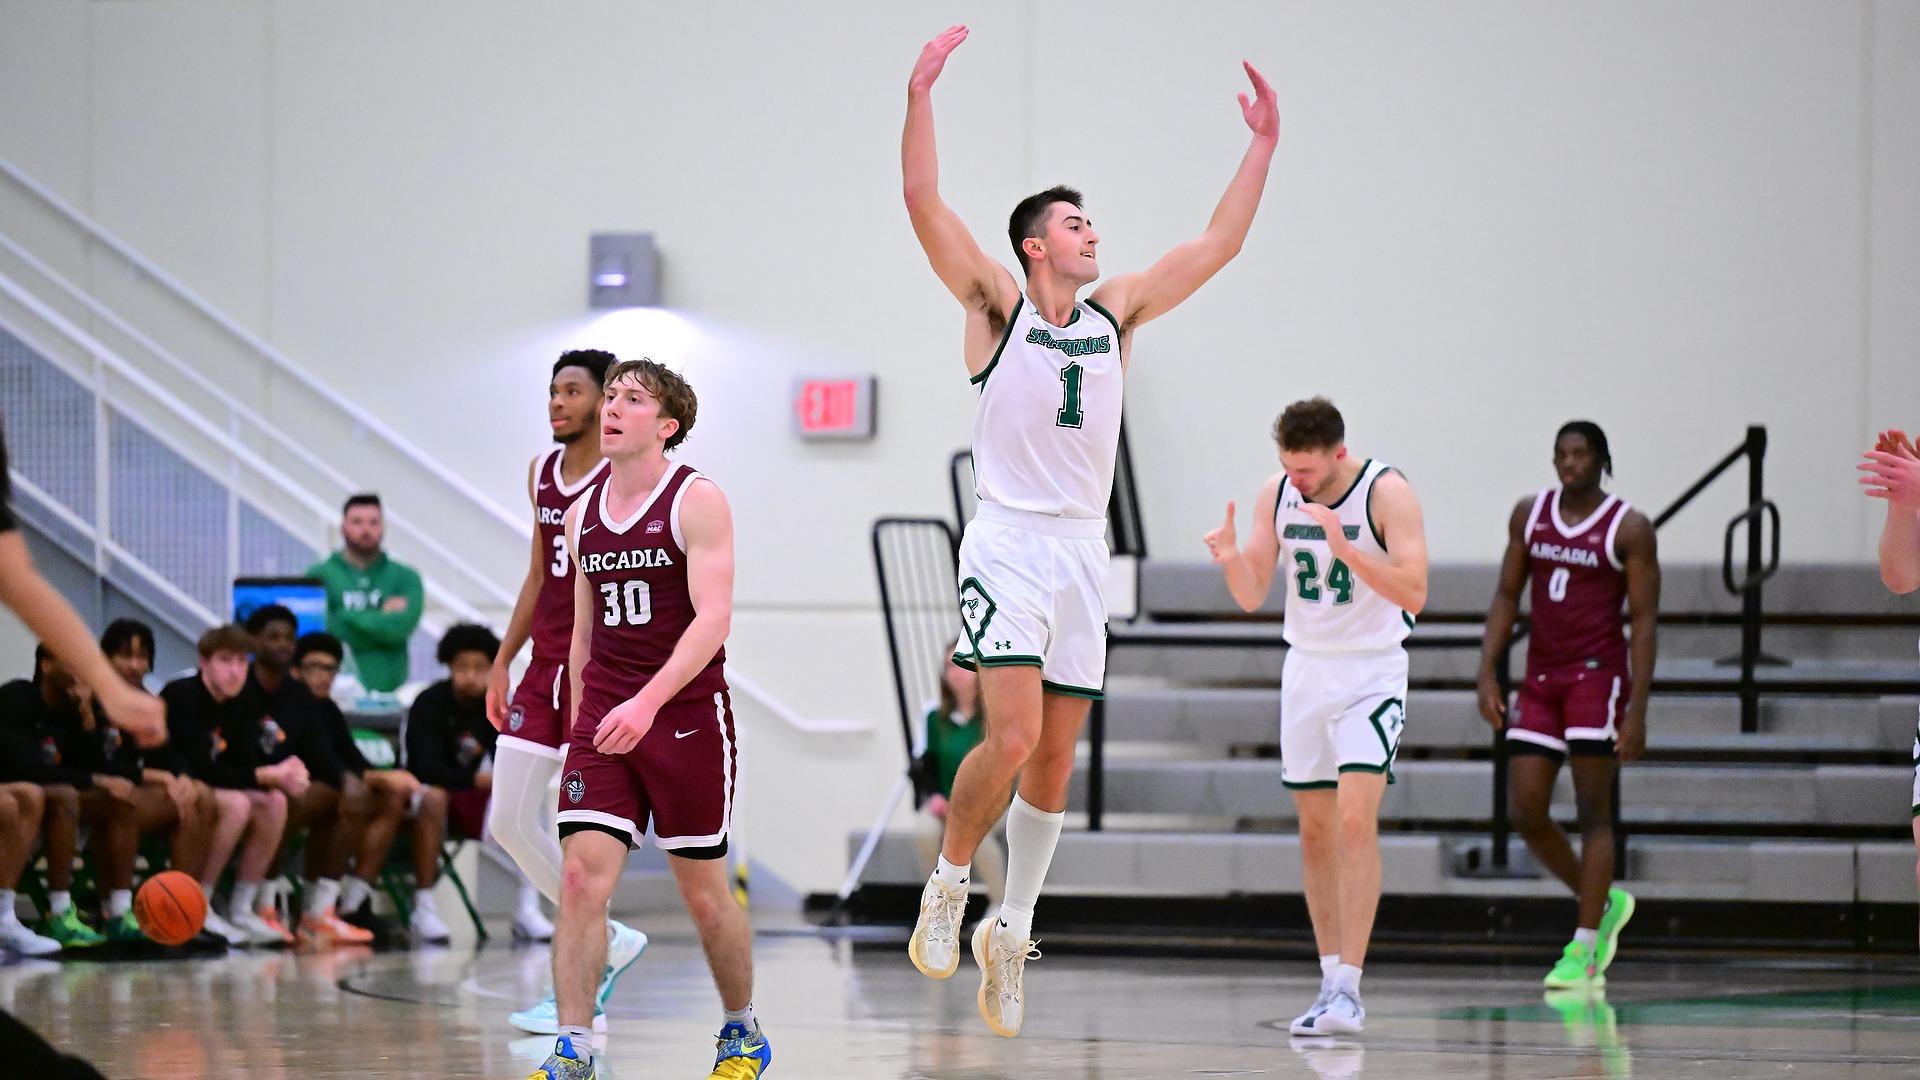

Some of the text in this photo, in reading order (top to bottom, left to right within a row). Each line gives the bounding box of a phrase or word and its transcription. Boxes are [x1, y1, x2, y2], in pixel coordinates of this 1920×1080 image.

[802, 381, 856, 430] EXIT
[1056, 361, 1083, 429] 1
[551, 534, 569, 577] 3
[581, 548, 673, 573] ARCADIA
[1293, 548, 1354, 605] 24
[1530, 542, 1599, 568] ARCADIA
[600, 579, 651, 626] 30
[1549, 567, 1570, 602] 0
